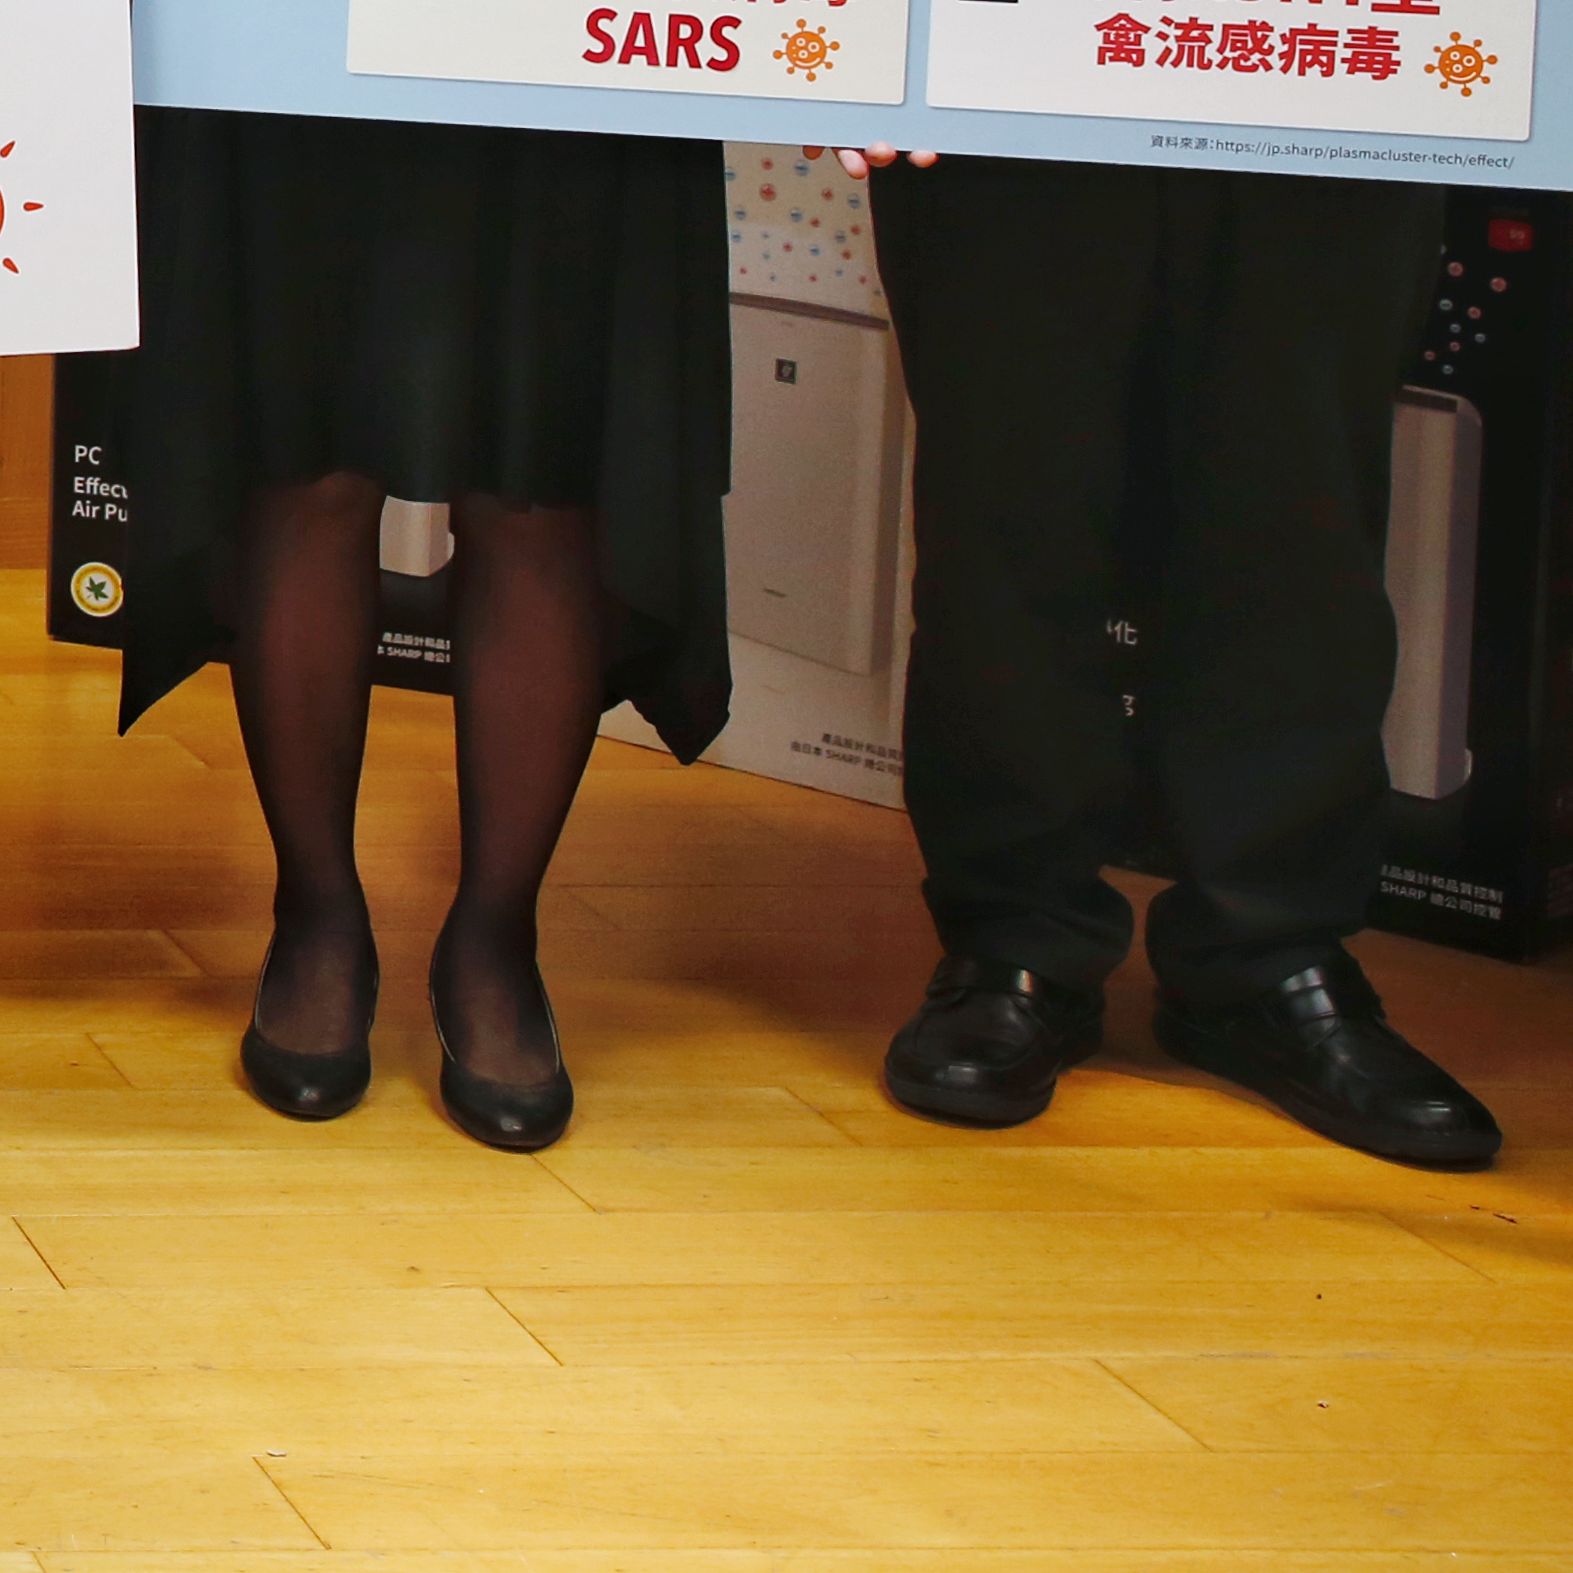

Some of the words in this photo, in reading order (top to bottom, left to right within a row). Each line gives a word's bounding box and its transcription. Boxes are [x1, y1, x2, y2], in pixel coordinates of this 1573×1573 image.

[582, 8, 742, 72] SARS
[1094, 11, 1402, 82] 禽流感病毒
[72, 500, 101, 519] Air
